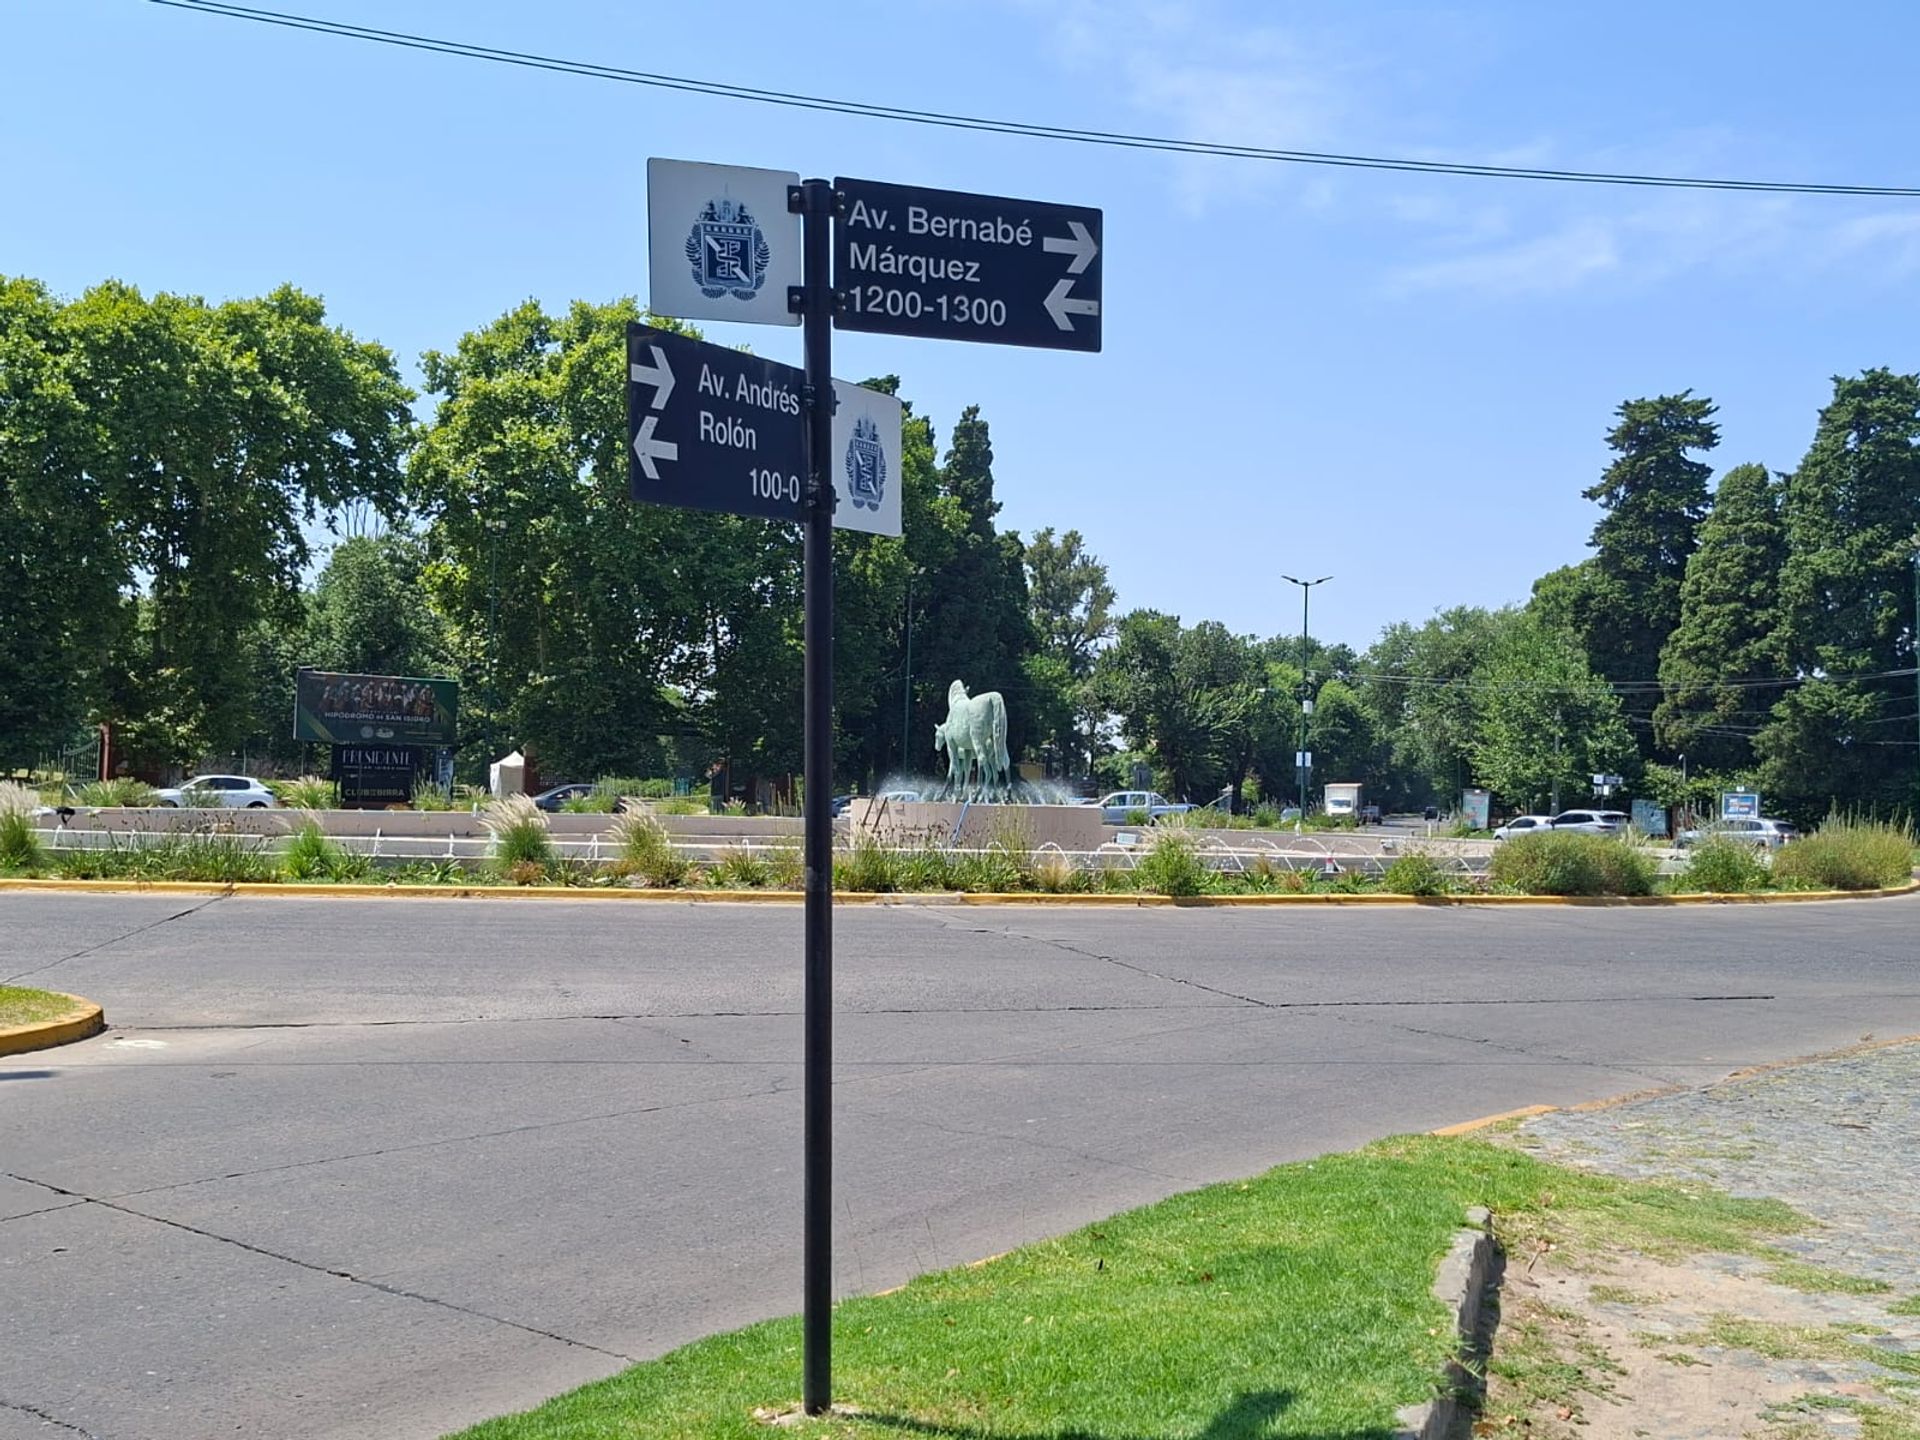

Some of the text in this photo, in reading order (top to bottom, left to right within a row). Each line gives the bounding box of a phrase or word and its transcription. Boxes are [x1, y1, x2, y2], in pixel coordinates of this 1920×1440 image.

[848, 199, 1033, 247] Av. Bernabé
[849, 241, 981, 284] Márquez
[849, 285, 1007, 327] 1200-1300
[698, 363, 800, 416] Av. Andrés
[699, 410, 757, 451] Rolón
[749, 468, 800, 503] 100-0
[342, 749, 410, 765] PRESIDENTE
